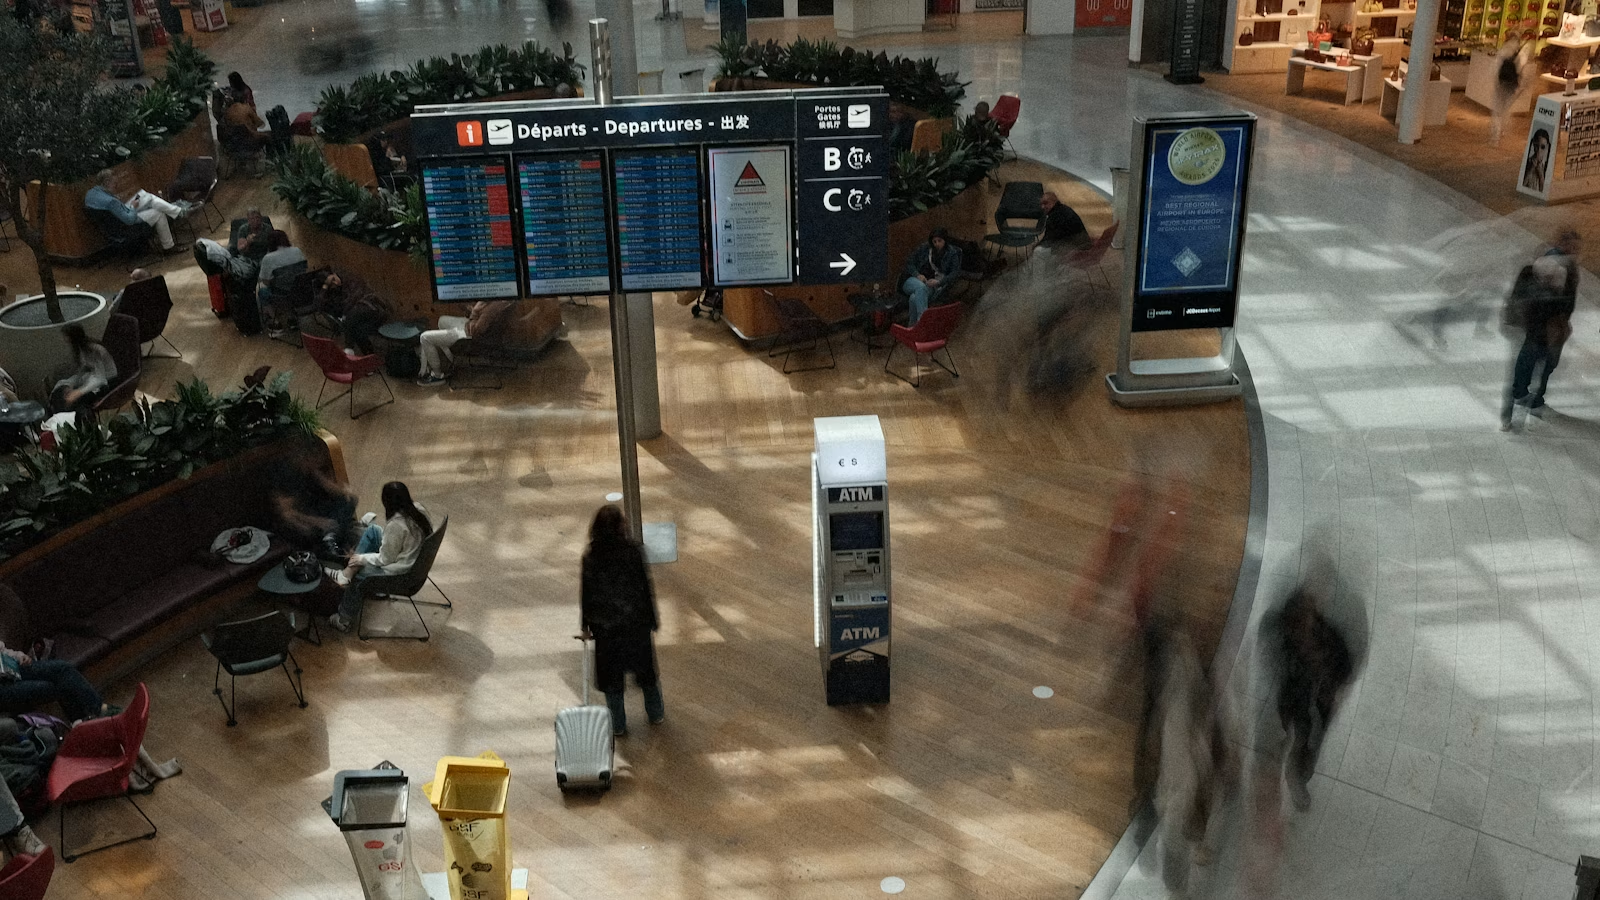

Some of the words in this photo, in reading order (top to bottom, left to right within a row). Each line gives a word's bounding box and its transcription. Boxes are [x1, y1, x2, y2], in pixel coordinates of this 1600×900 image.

[814, 105, 841, 113] Portes
[817, 113, 841, 121] Gates
[517, 123, 587, 142] Départs
[604, 118, 703, 137] Departures
[721, 114, 750, 130] 出发
[824, 147, 841, 171] B
[853, 153, 863, 162] 11
[823, 188, 841, 212] C
[856, 195, 862, 203] 7
[839, 487, 873, 502] ATM
[840, 627, 880, 640] ATM
